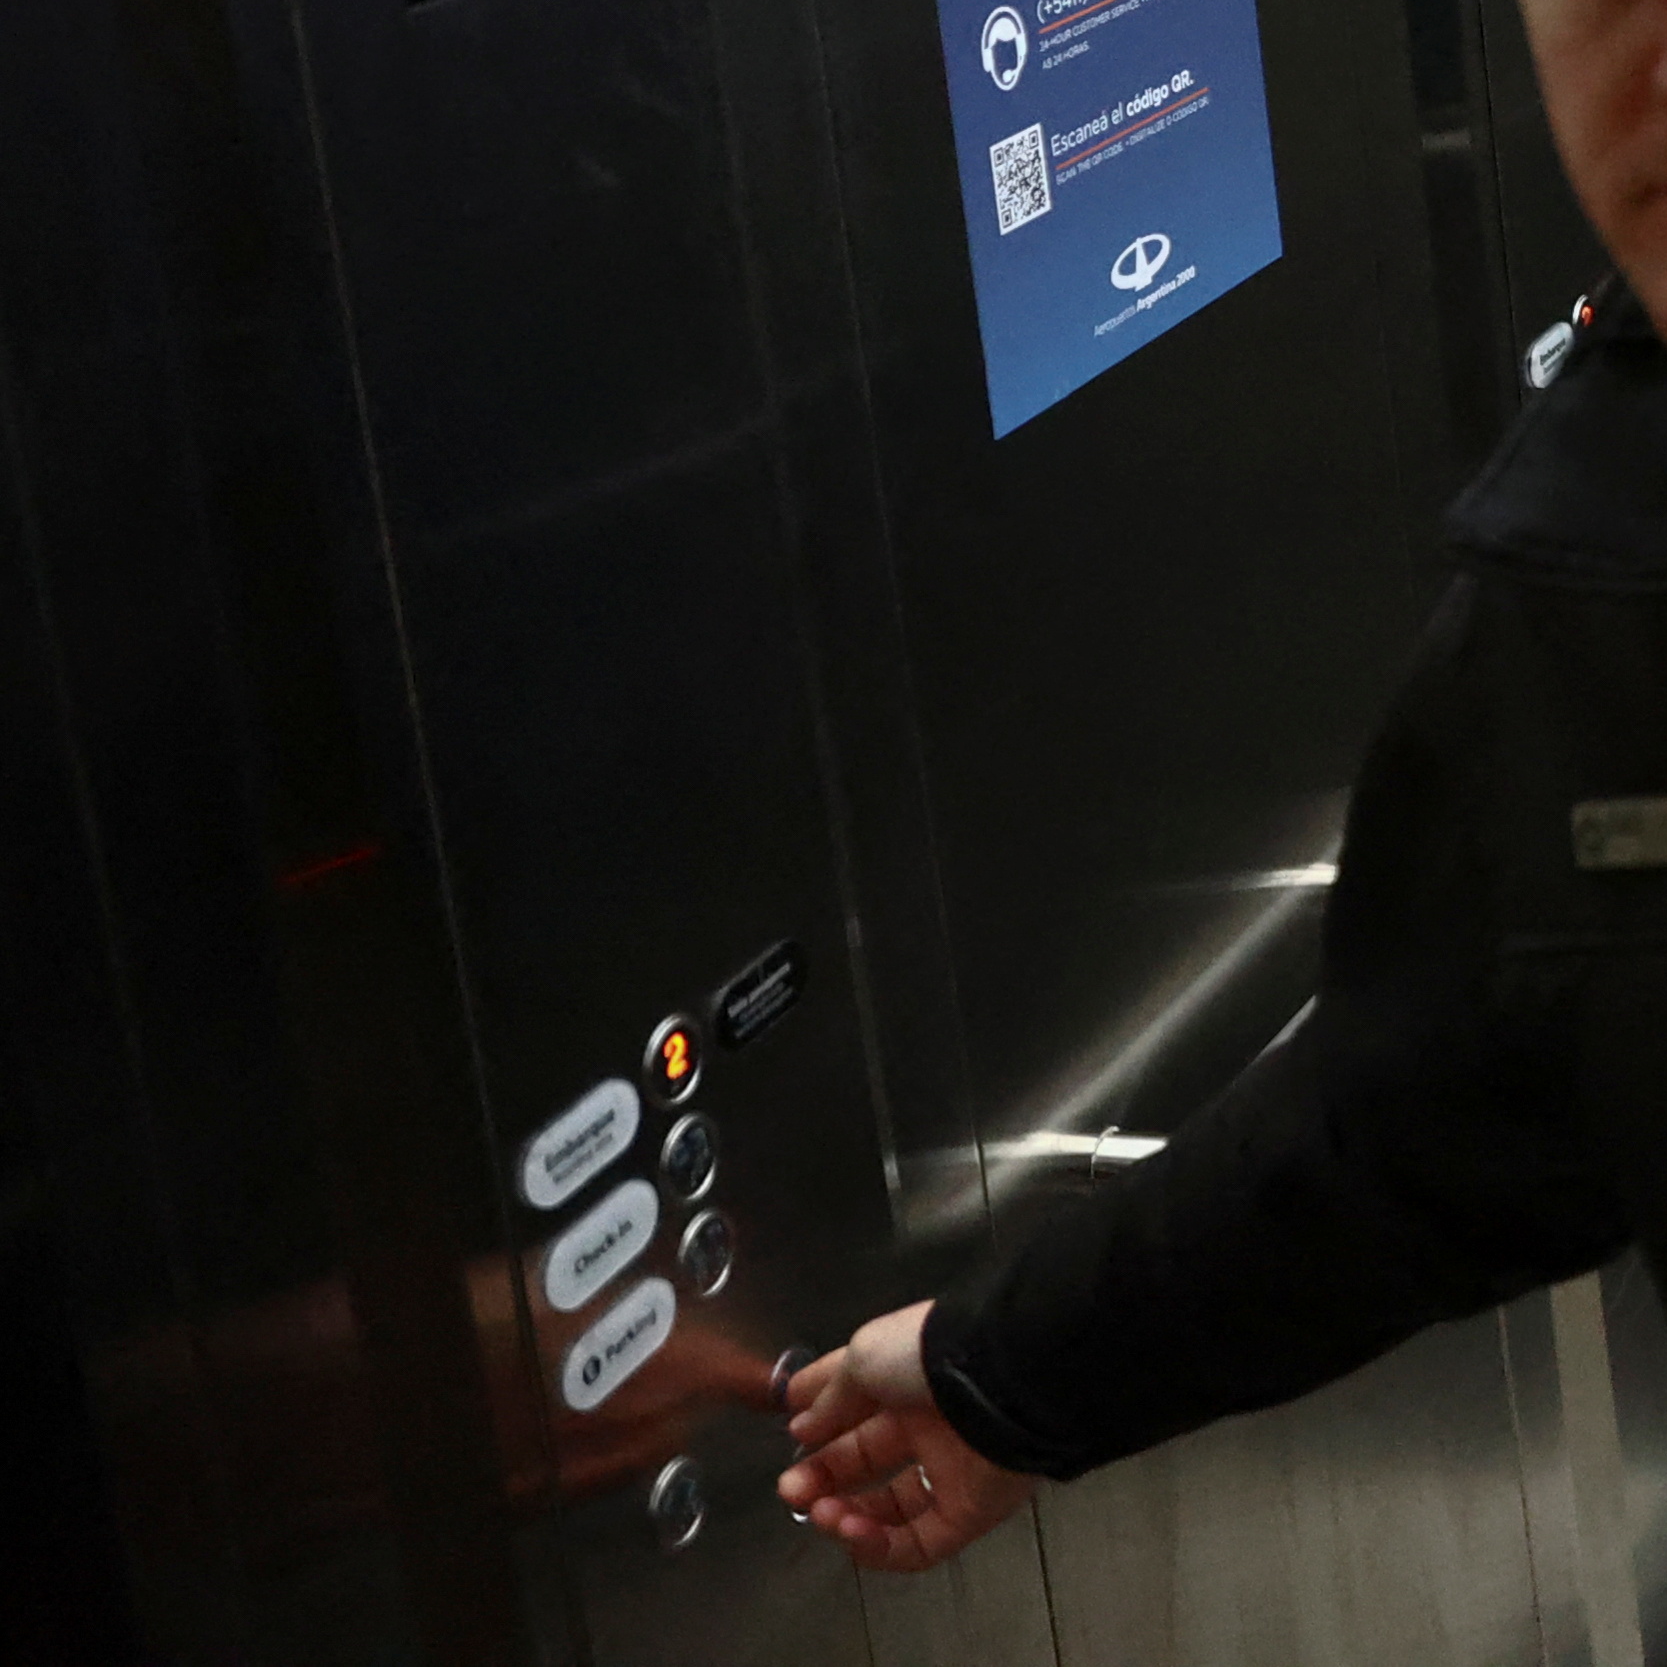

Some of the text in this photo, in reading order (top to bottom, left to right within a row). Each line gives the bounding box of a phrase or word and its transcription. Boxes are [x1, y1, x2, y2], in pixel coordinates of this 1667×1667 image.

[1050, 69, 1195, 157] Escaneá el código QR.
[662, 1032, 690, 1081] 2
